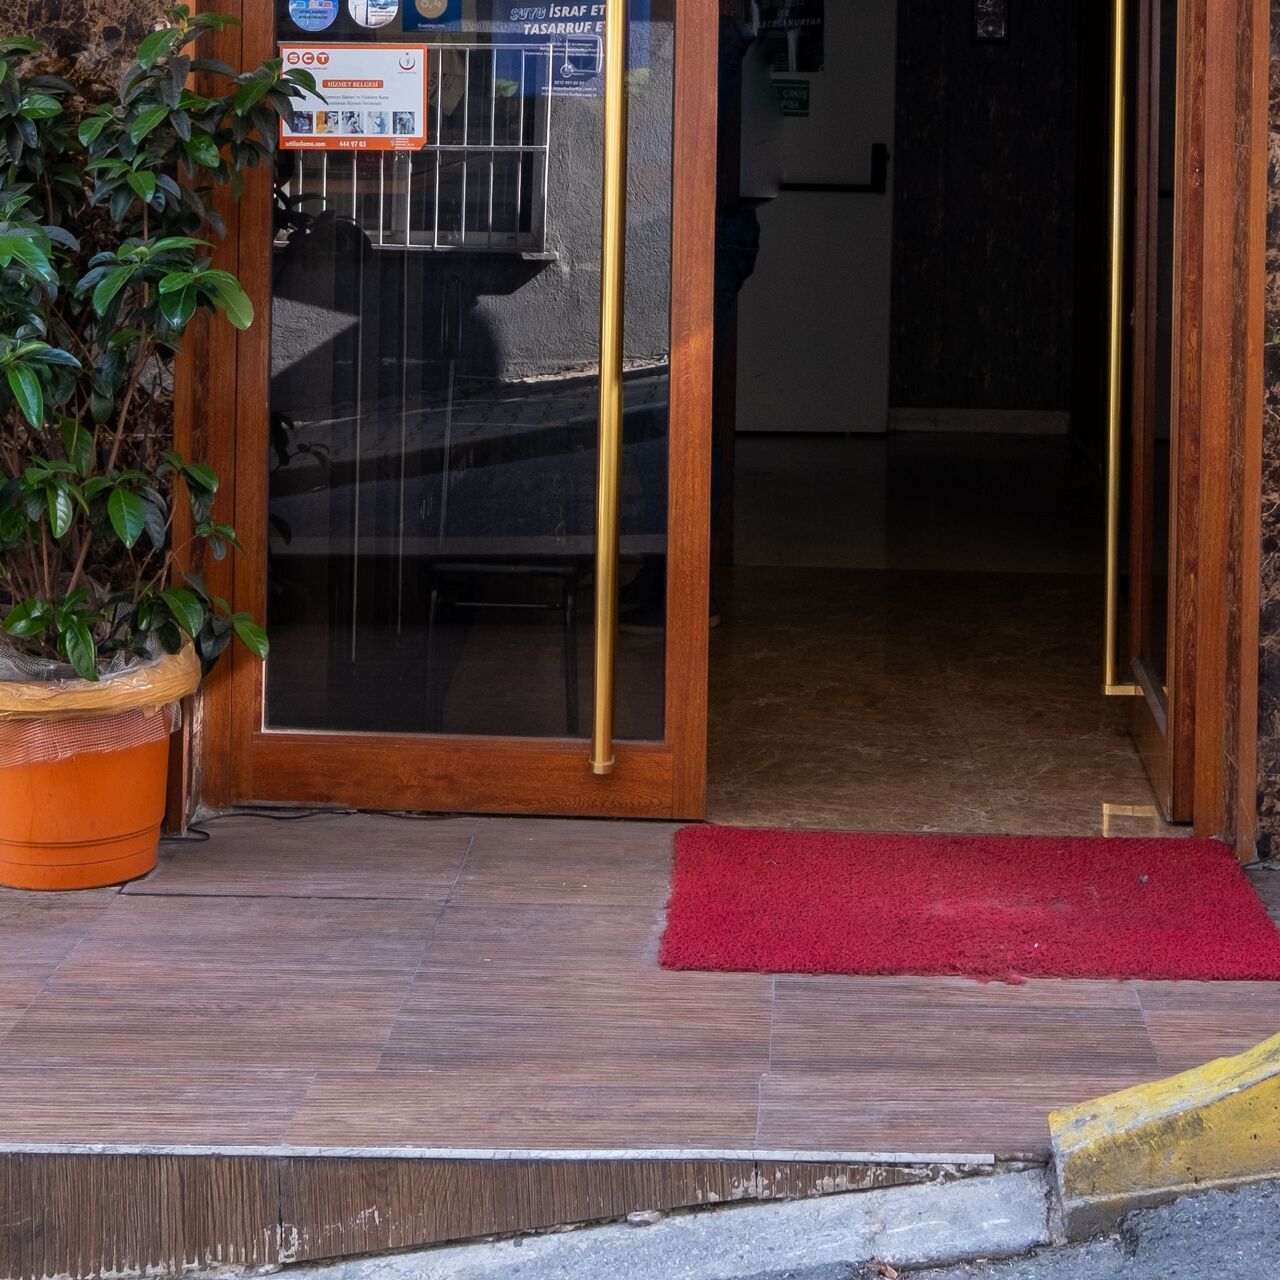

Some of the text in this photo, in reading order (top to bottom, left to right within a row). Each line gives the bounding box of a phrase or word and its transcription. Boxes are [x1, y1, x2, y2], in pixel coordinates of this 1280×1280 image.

[509, 7, 548, 20] SUYU
[548, 3, 588, 18] İSRAF
[523, 22, 593, 35] TASARRUF
[287, 52, 329, 65] SCT
